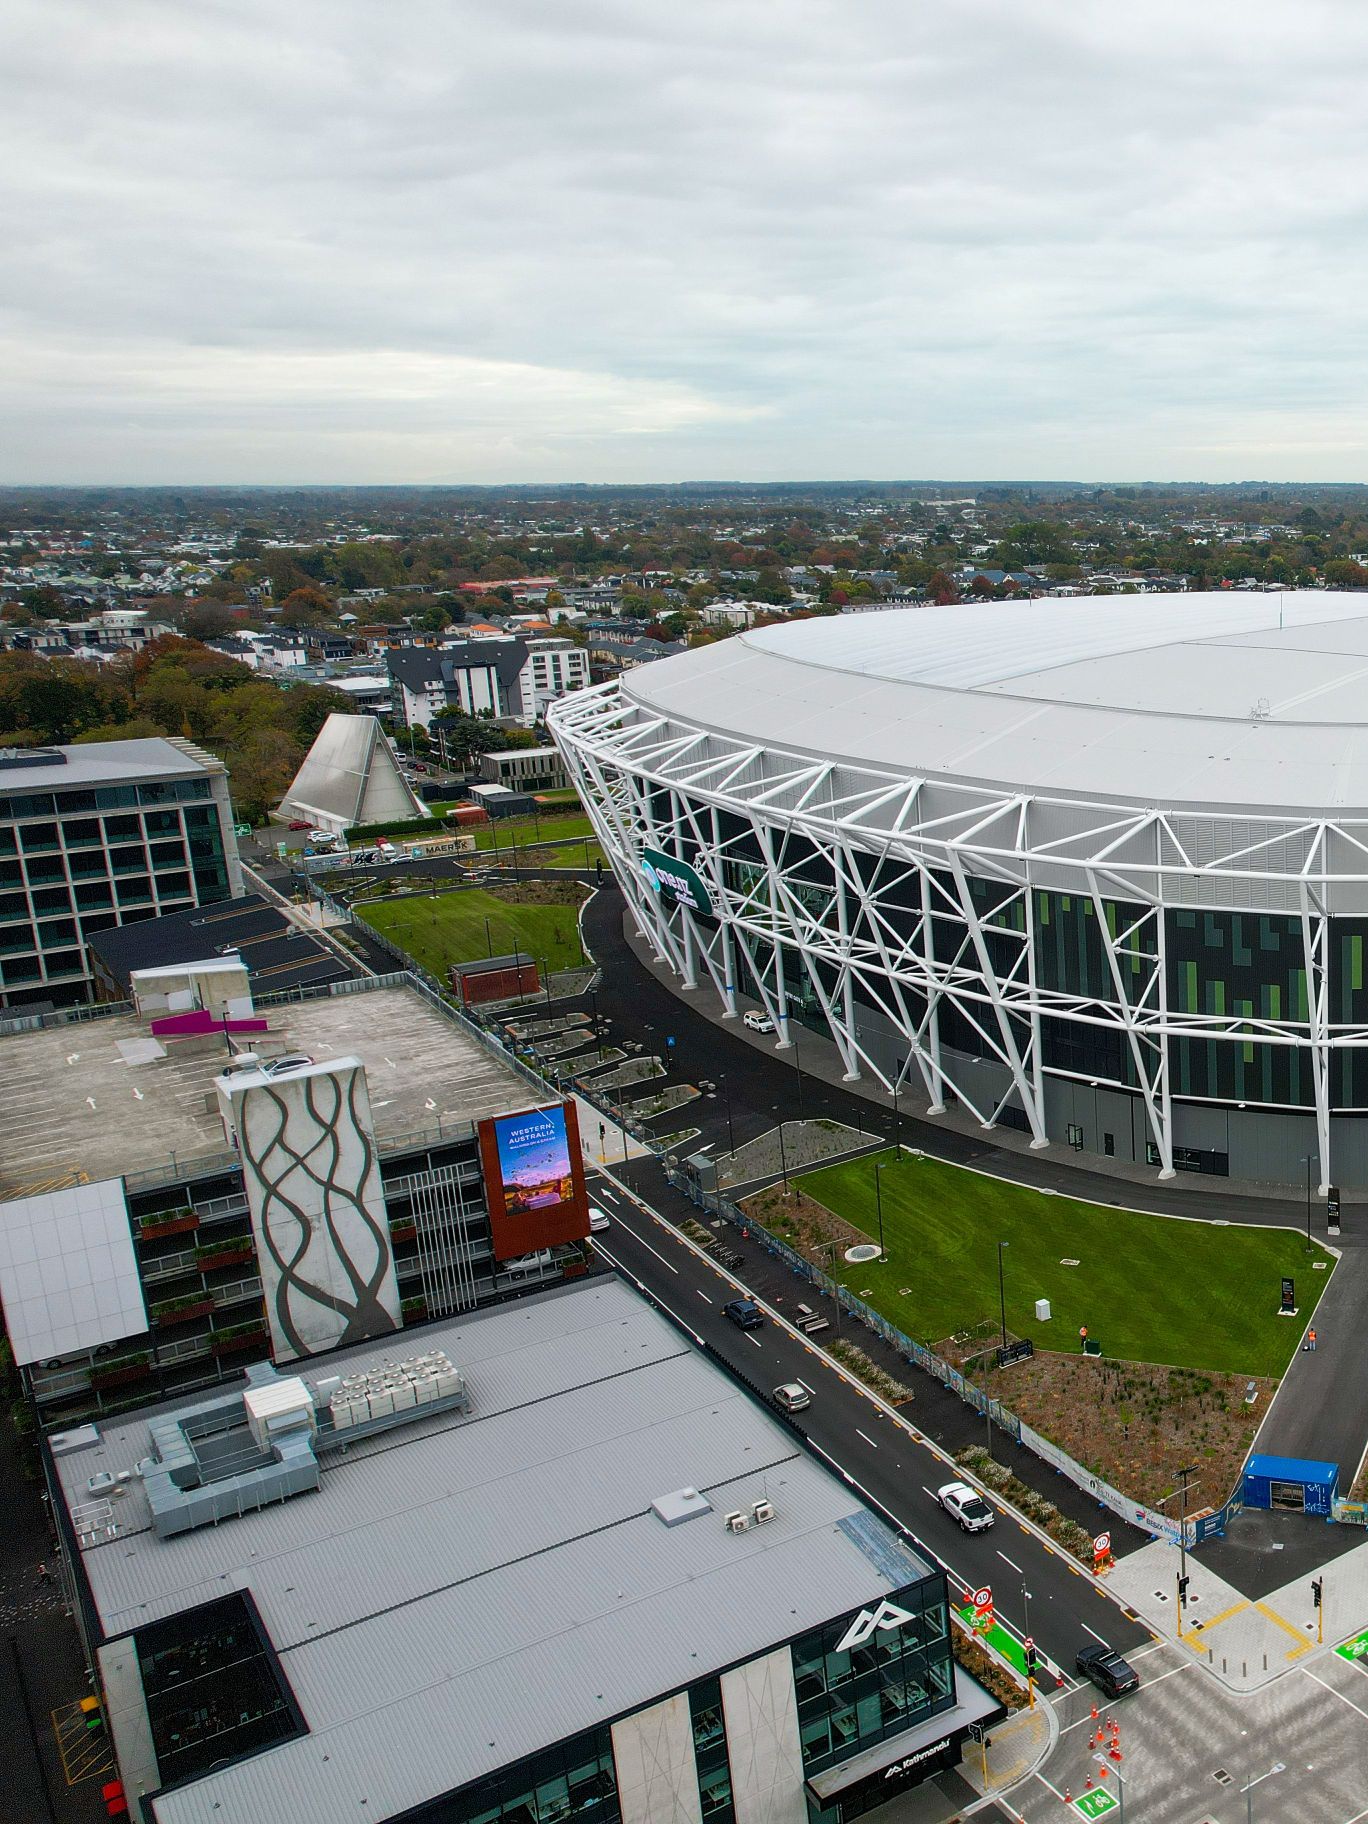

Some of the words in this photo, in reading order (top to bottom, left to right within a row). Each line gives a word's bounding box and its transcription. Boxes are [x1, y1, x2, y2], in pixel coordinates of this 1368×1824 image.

[425, 842, 468, 854] MAERSK
[508, 1129, 555, 1145] AUSTRALIA
[511, 1123, 551, 1137] WESTERN
[902, 1737, 951, 1769] Kathmandu
